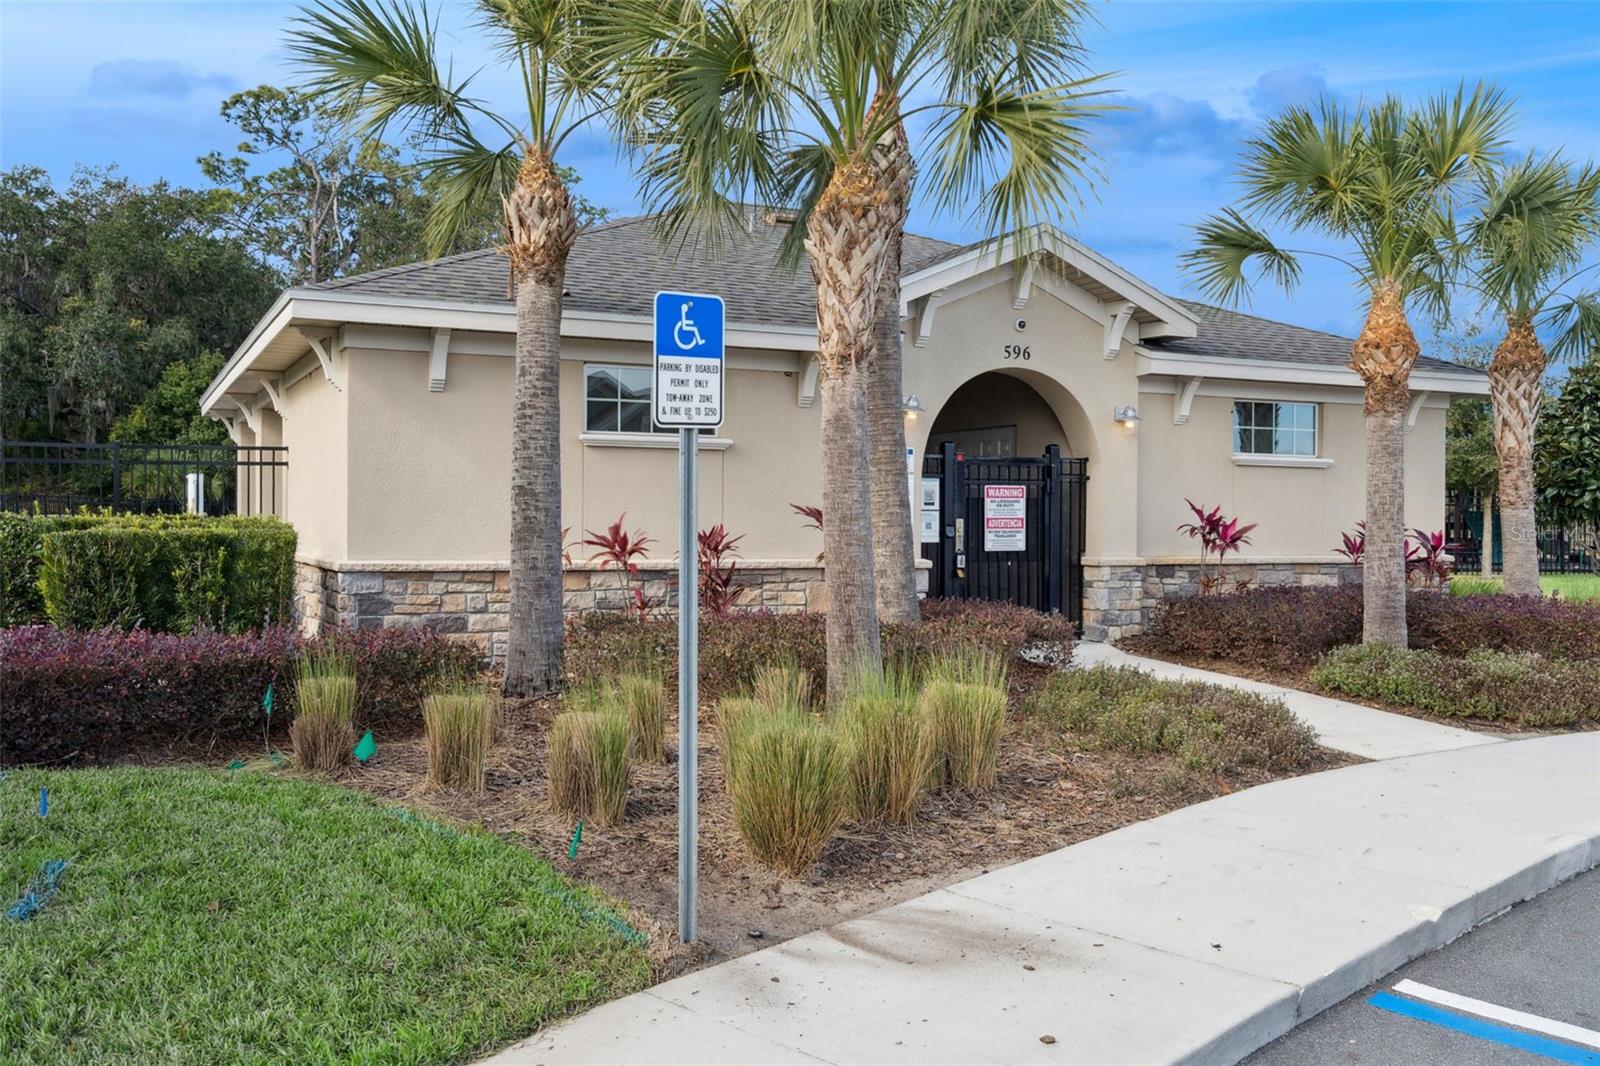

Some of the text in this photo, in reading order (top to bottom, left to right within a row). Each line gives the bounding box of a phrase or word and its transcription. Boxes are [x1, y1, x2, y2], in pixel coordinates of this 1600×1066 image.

[1004, 345, 1030, 360] 596
[660, 363, 682, 372] PARKING
[695, 365, 719, 374] DISABLED
[670, 379, 708, 388] PERMIT ONLY
[666, 394, 712, 403] TOW-AWAY ZONE
[670, 407, 681, 415] FINE
[685, 408, 691, 416] UP
[704, 408, 717, 416] $250
[988, 488, 1022, 497] WARNING
